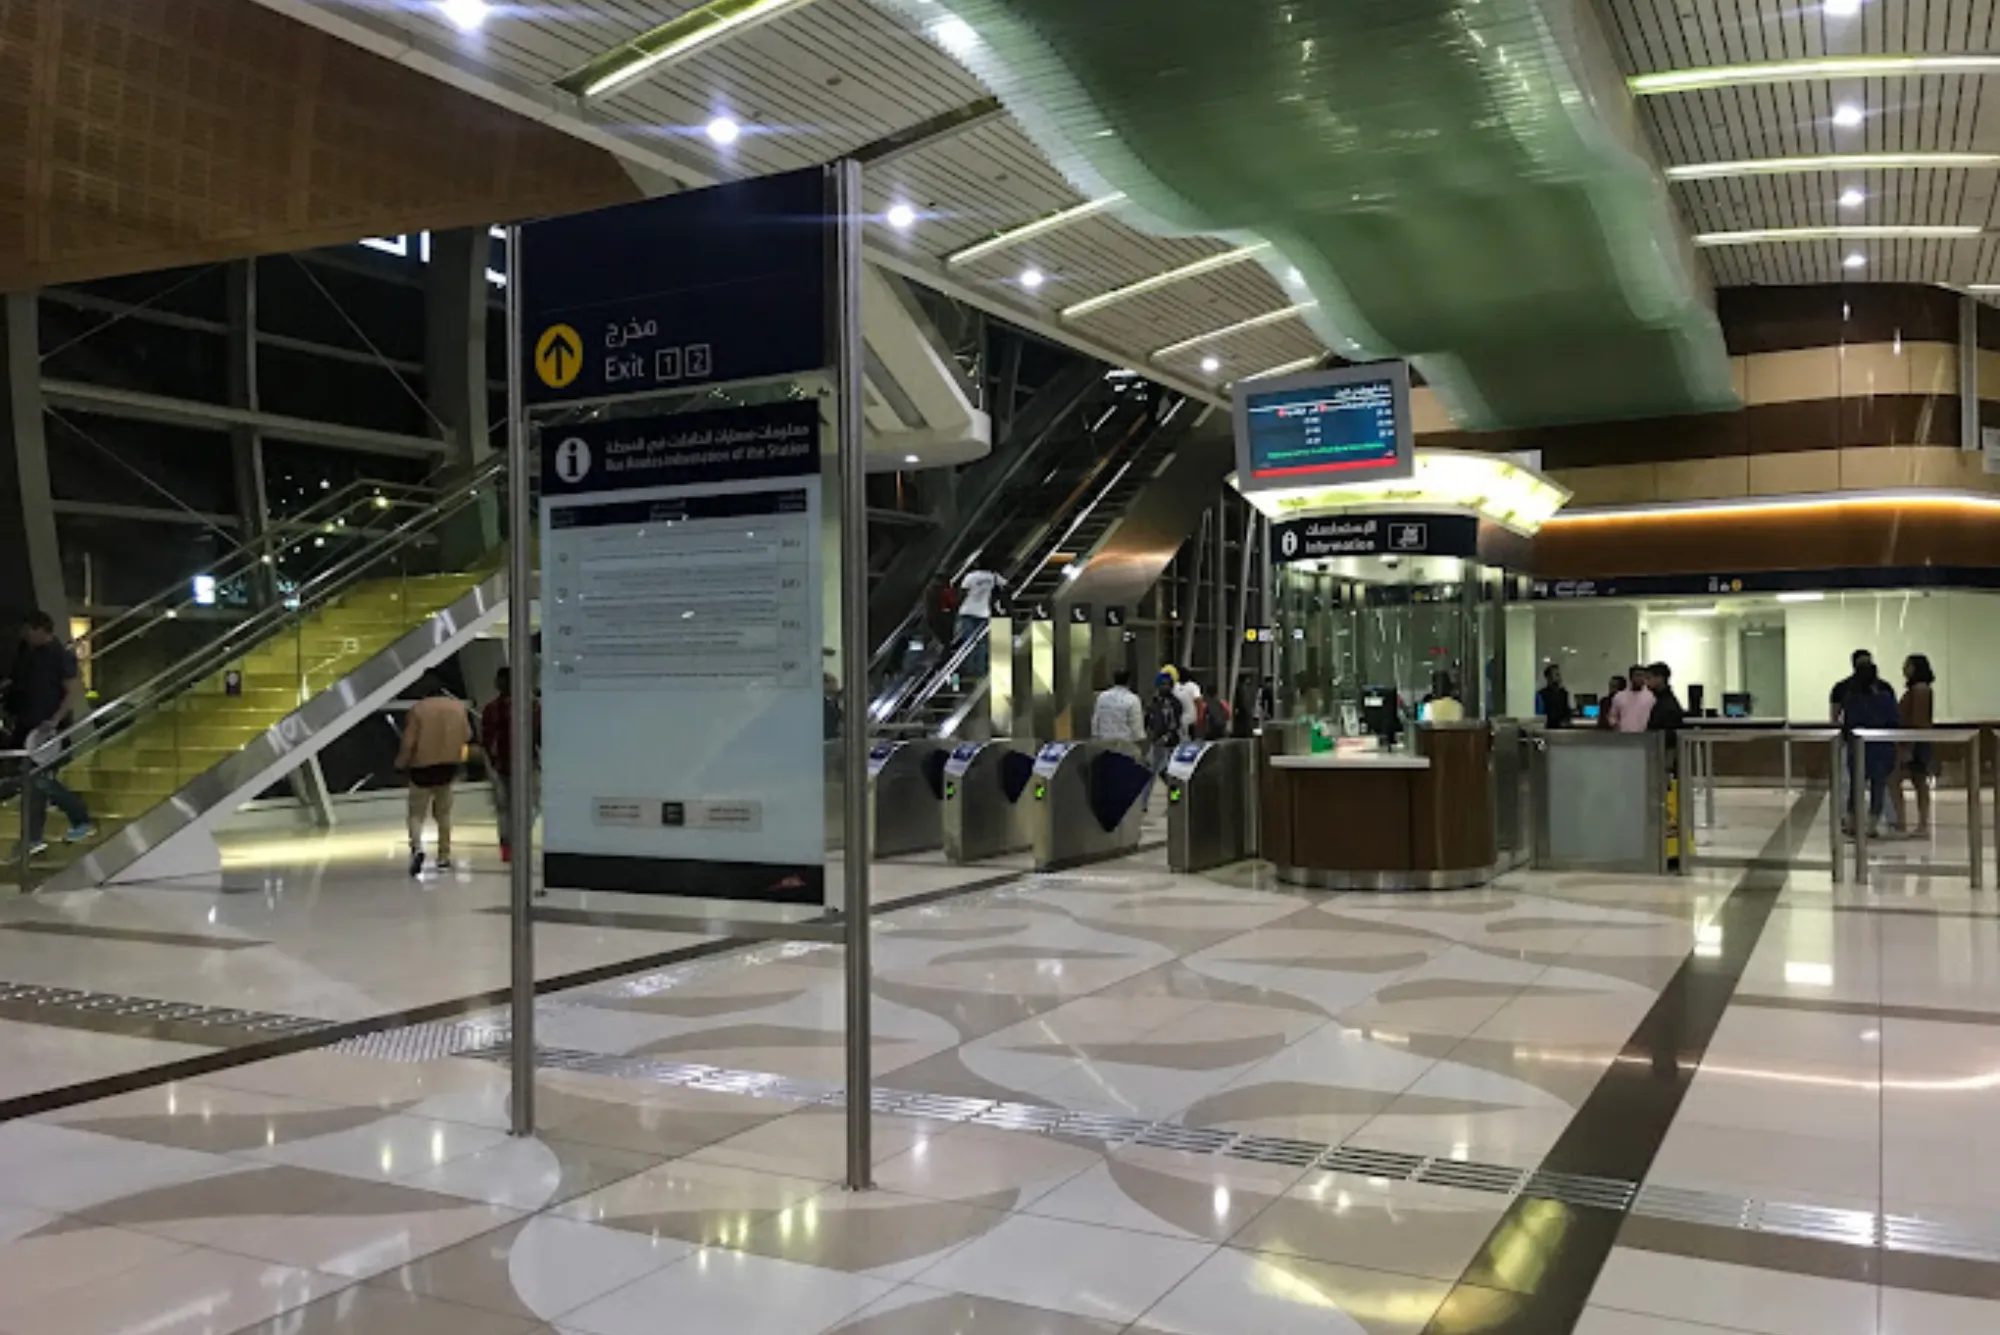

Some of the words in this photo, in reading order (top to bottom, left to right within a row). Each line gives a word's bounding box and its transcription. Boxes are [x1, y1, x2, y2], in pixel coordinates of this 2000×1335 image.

[605, 317, 657, 348] مخرج
[605, 352, 645, 382] Exit
[1305, 538, 1375, 553] Information
